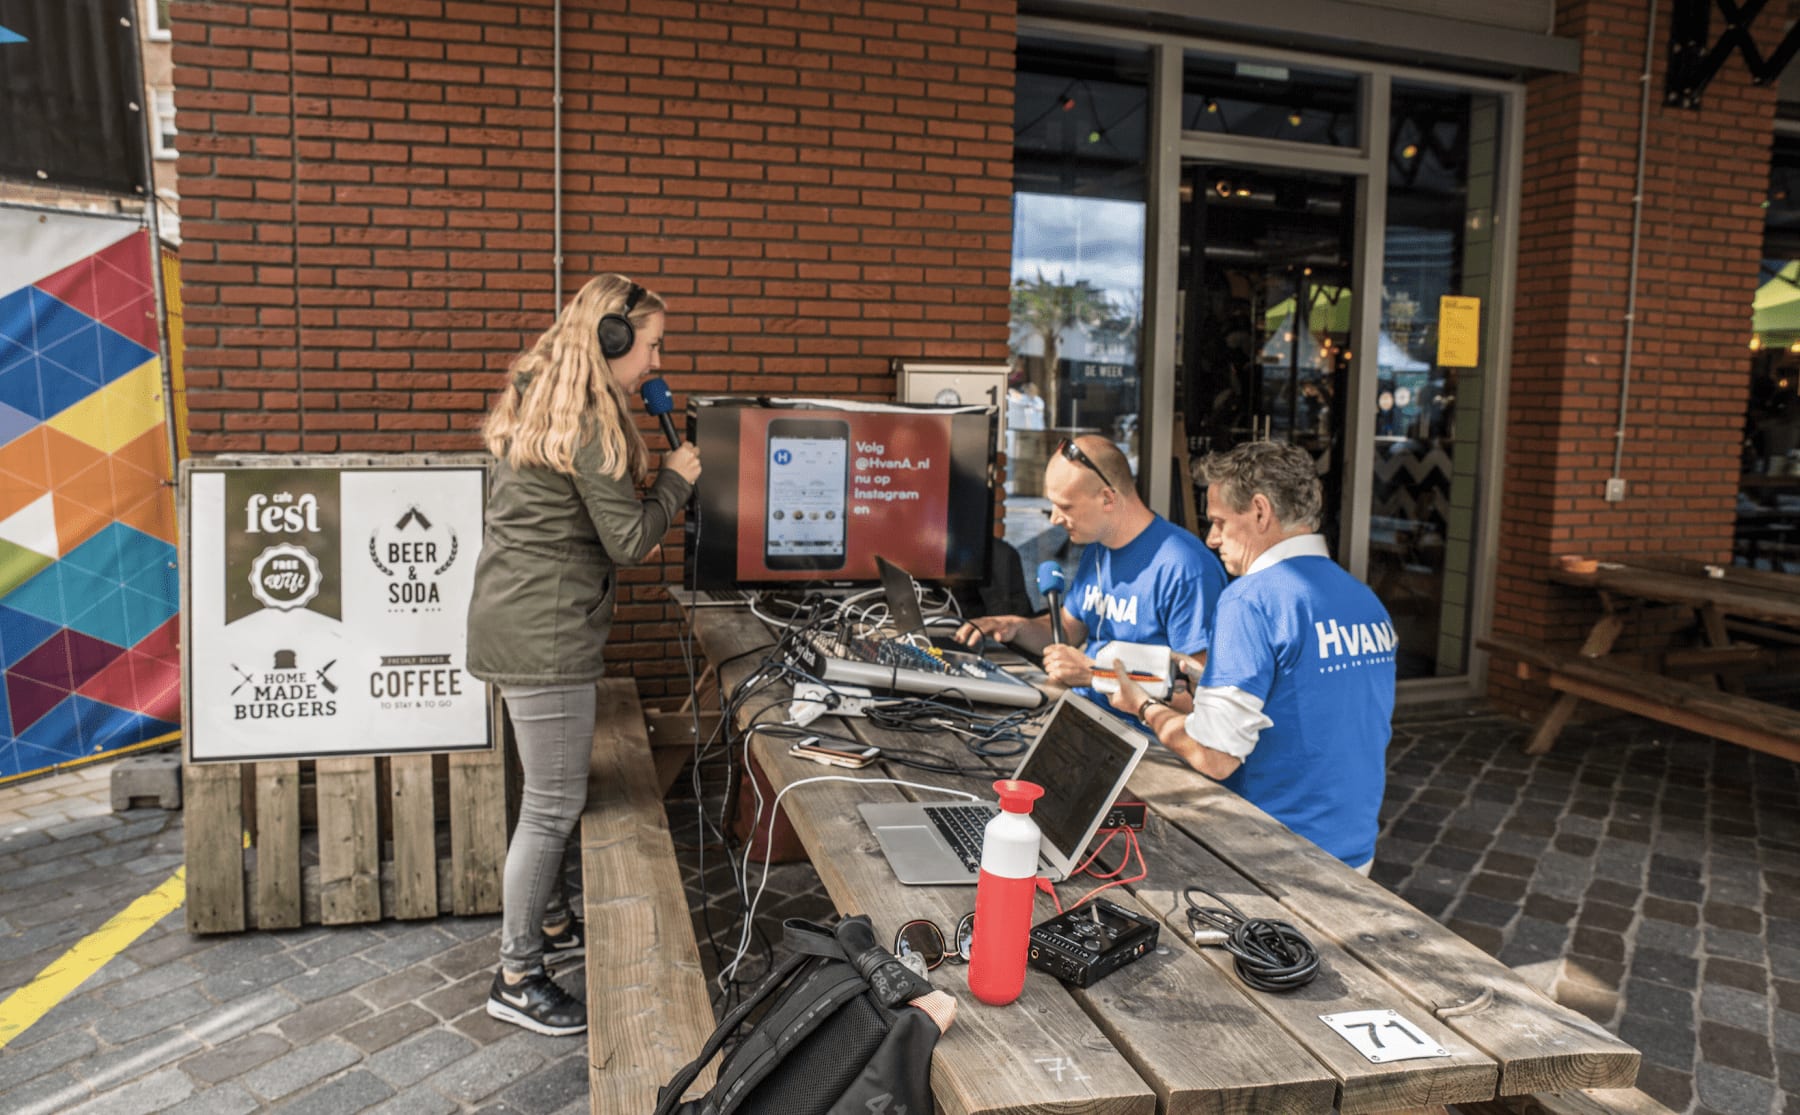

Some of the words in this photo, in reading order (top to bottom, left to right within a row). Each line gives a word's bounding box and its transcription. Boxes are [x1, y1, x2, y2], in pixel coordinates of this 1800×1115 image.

[1085, 365, 1096, 377] DE
[1099, 366, 1123, 377] WEEK
[856, 442, 885, 455] Volg
[856, 457, 930, 471] @HvanA_nl
[855, 475, 871, 484] nu
[874, 475, 891, 486] op
[244, 493, 321, 533] fest
[853, 506, 870, 515] en
[388, 542, 437, 563] BEER
[272, 559, 299, 570] FREE
[408, 565, 417, 581] &
[388, 582, 440, 604] SODA
[264, 672, 306, 684] HOME
[370, 669, 462, 698] COFFEE
[254, 684, 317, 701] MADE
[235, 701, 337, 720] BURGERS
[1344, 1019, 1425, 1049] 71
